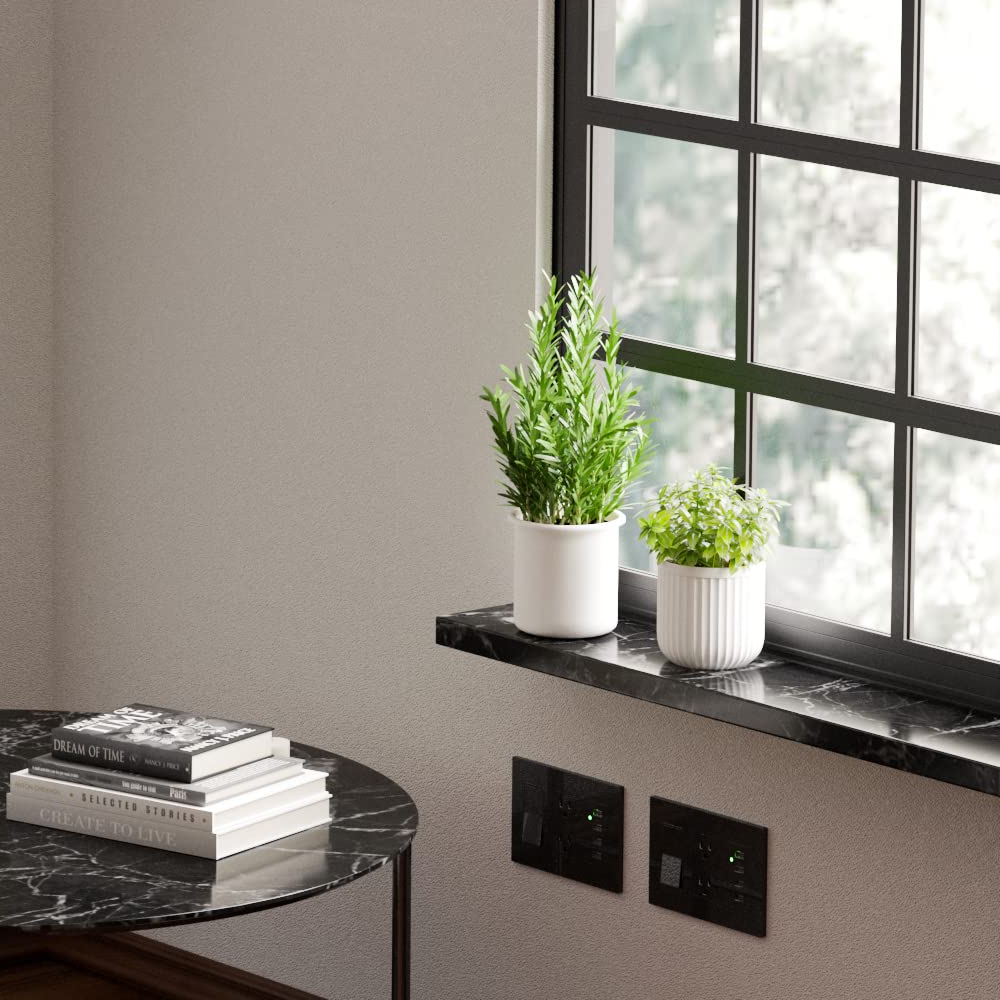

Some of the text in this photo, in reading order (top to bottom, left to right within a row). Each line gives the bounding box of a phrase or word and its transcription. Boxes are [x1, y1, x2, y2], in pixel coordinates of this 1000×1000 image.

[77, 710, 163, 734] TIME
[53, 738, 85, 756] DREAM
[88, 745, 100, 759] OF
[103, 747, 124, 763] TIME
[169, 787, 187, 800] Paris
[81, 793, 195, 823] SELECTED STORIES
[40, 807, 177, 847] CREATE TO LIVE
